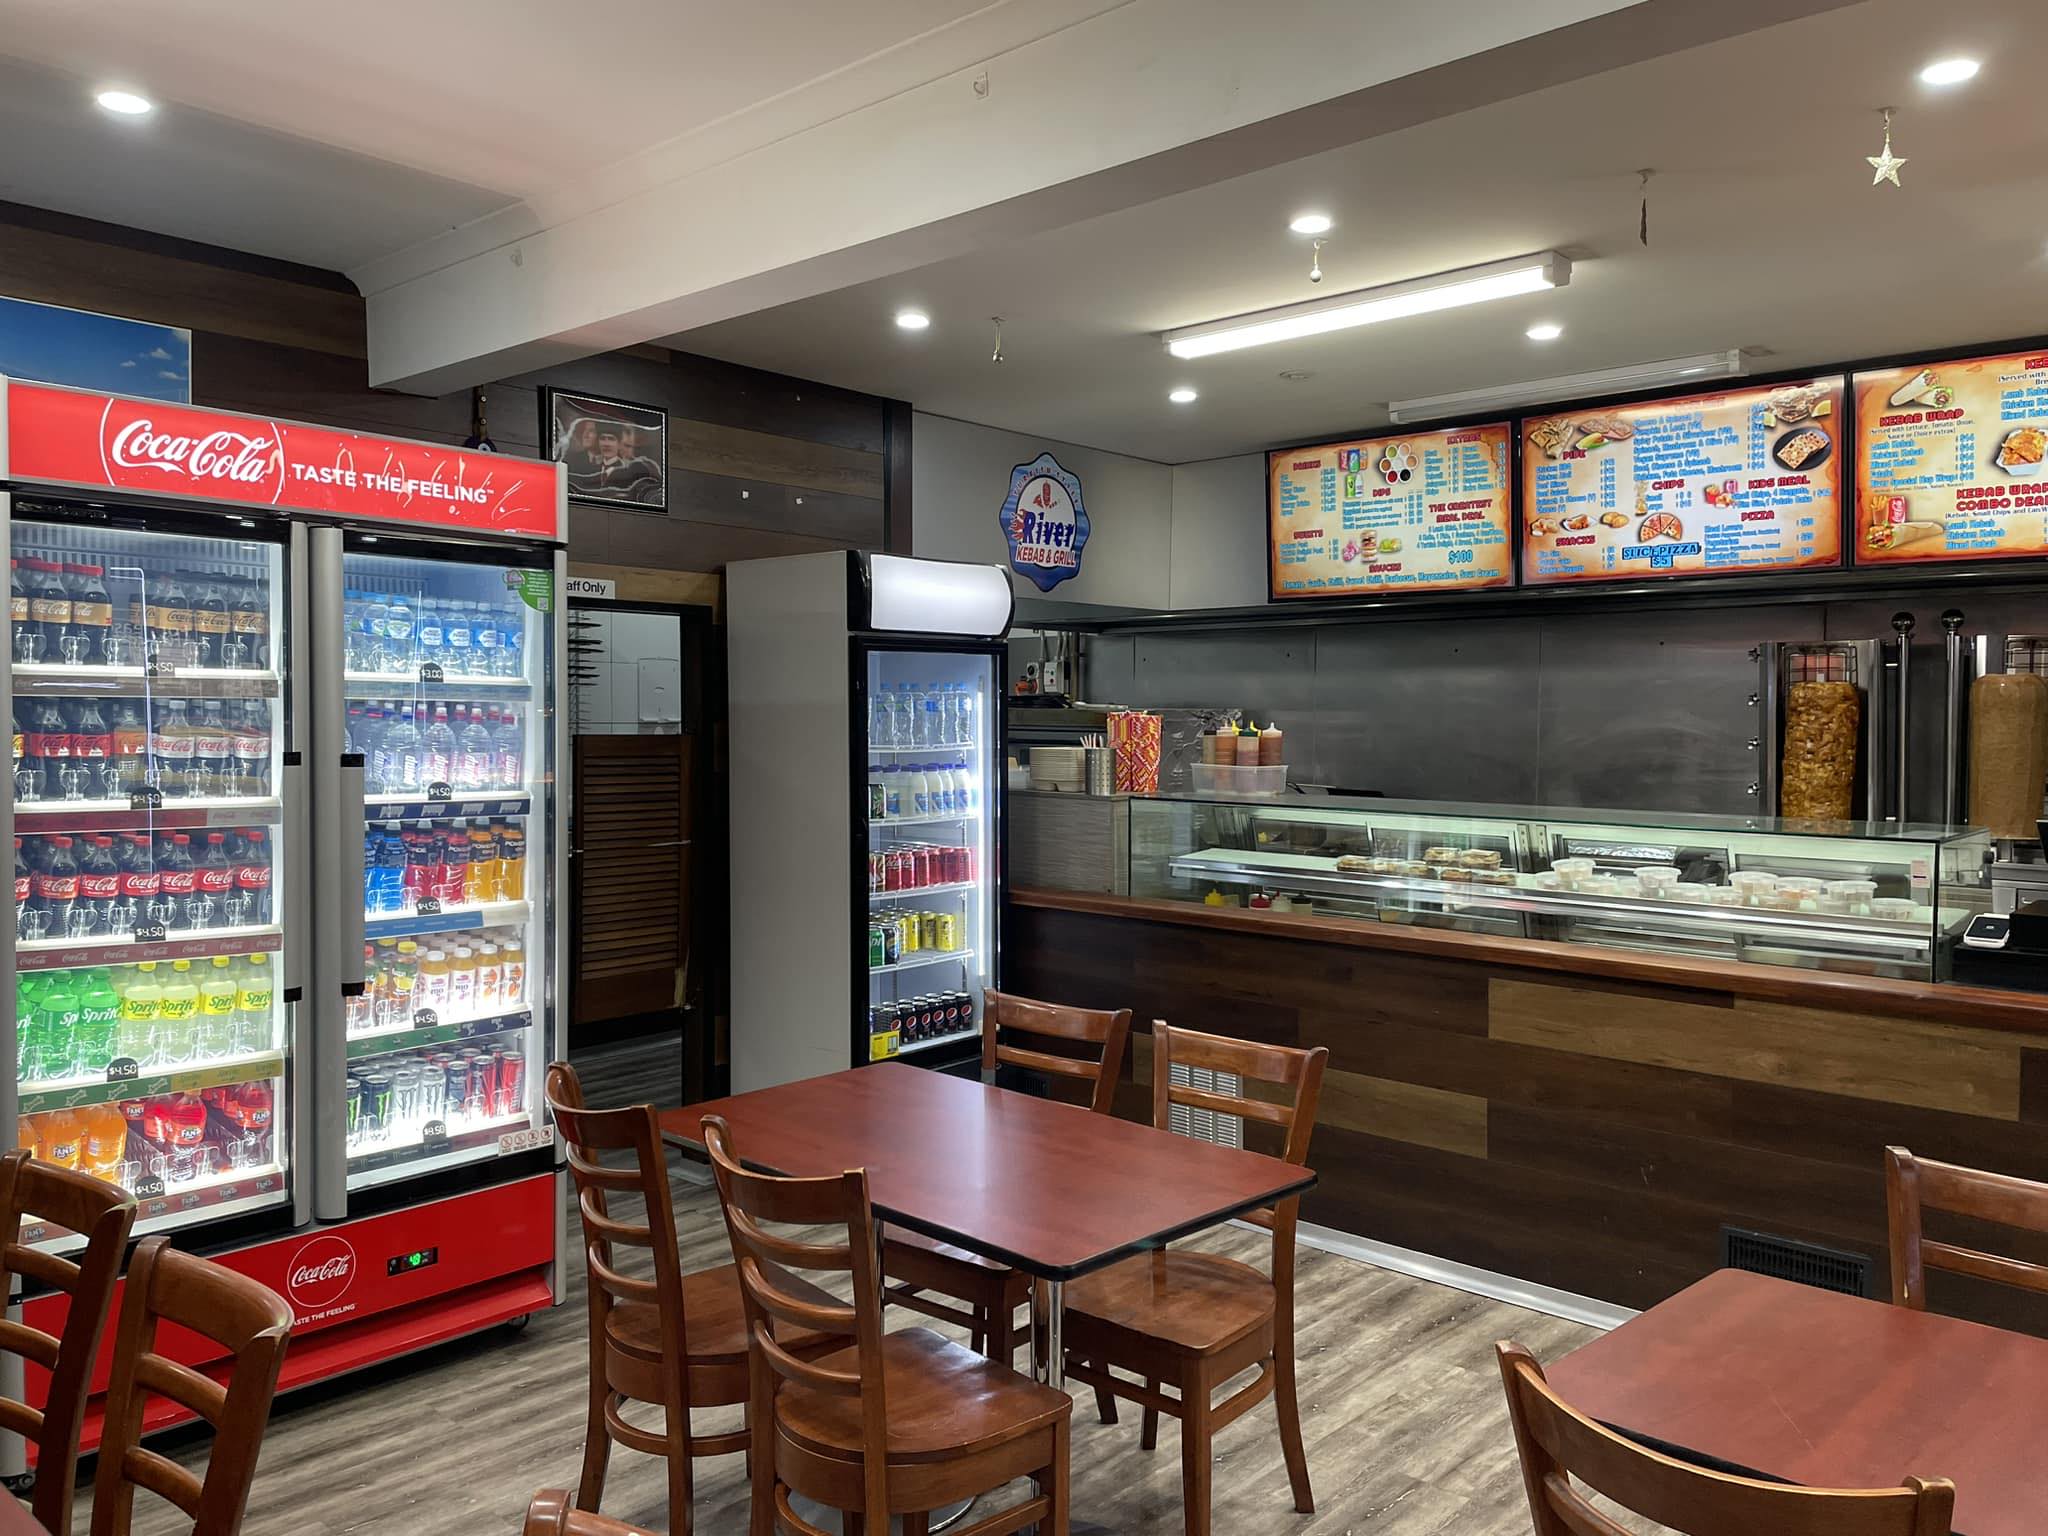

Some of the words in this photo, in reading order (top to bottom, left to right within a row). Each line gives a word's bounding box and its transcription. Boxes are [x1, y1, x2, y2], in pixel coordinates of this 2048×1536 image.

[1880, 413, 1922, 427] KEBAB
[1926, 408, 1964, 421] WRAP
[112, 419, 274, 483] Coca-Cola
[291, 463, 357, 488] TASTE
[363, 473, 401, 493] THE
[1652, 479, 1684, 490] CHIPS
[1748, 477, 1775, 489] KIDS
[1778, 475, 1811, 487] MEAL
[1956, 486, 2005, 499] KEBAB
[1956, 498, 2011, 511] COMBO
[1741, 511, 1775, 521] PIZZA
[1022, 511, 1074, 547] River
[1556, 535, 1595, 547] SNACKS
[1017, 546, 1044, 563] KEBAB
[1046, 550, 1051, 563] &
[1053, 549, 1076, 566] GRILL
[1659, 543, 1698, 556] PIZZA
[1653, 556, 1669, 567] $5
[566, 581, 581, 591] aff
[582, 581, 606, 595] Only
[136, 926, 164, 938] $4.50
[109, 1064, 137, 1075] $4.50
[136, 1183, 163, 1194] $4.50
[292, 1254, 352, 1288] Coca-Cola
[294, 1316, 310, 1326] STE
[312, 1312, 325, 1320] THE
[327, 1303, 356, 1317] FEELING
